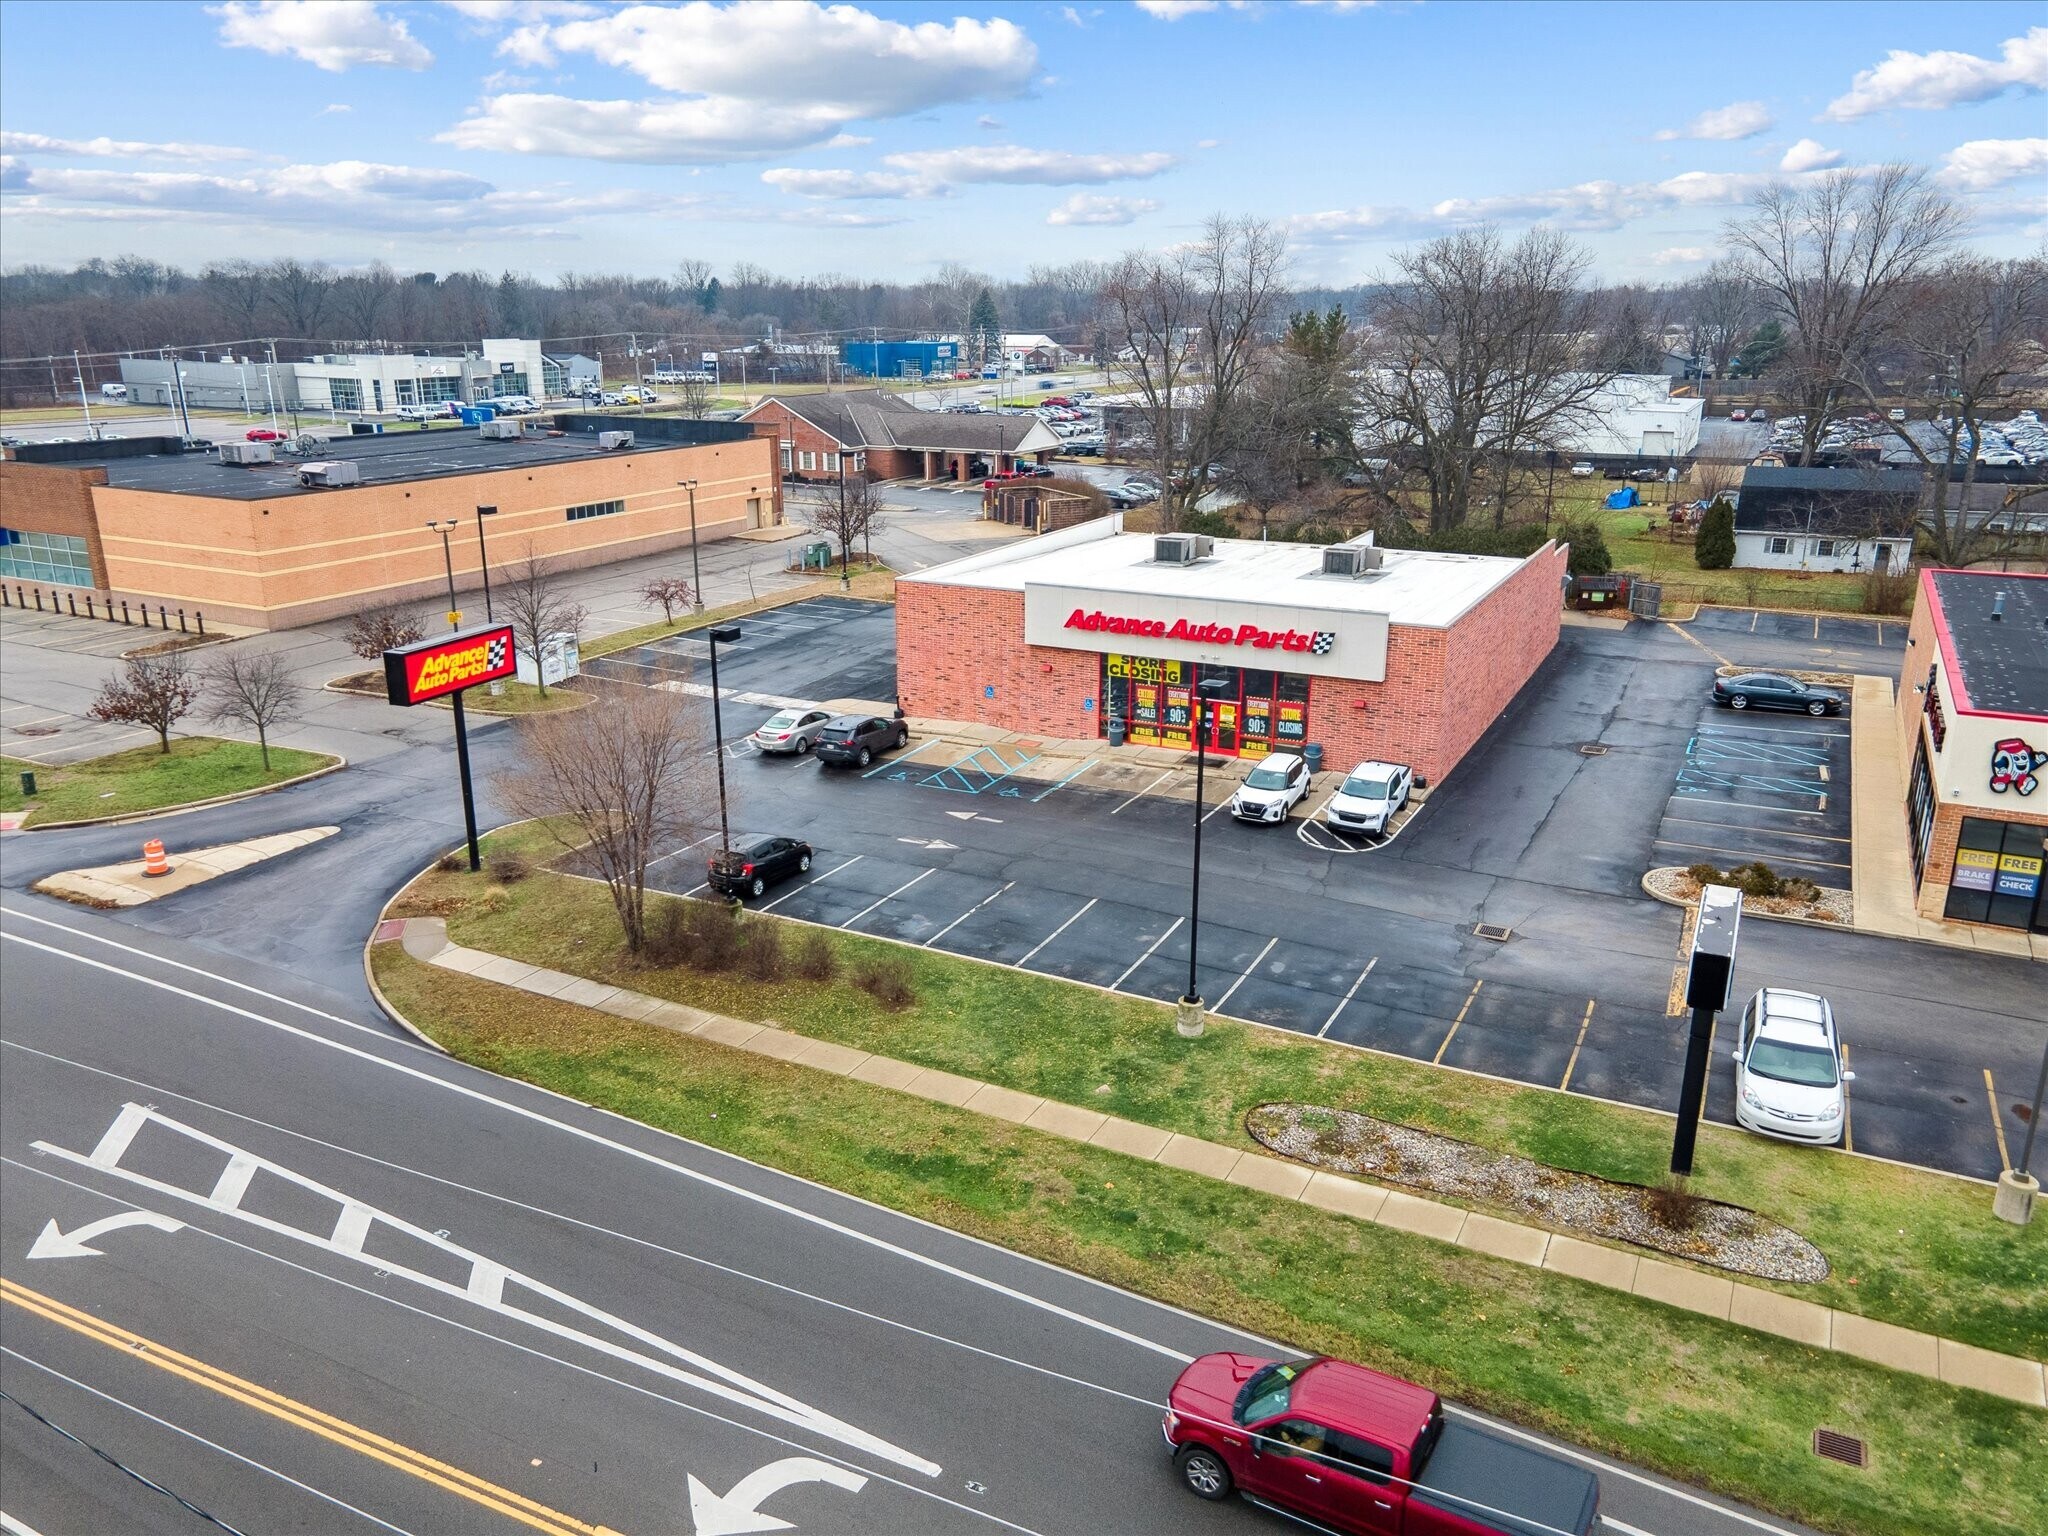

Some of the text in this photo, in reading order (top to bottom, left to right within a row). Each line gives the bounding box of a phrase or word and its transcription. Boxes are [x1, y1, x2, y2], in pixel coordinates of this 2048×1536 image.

[1064, 609, 1309, 652] Advance Auto Parts
[420, 645, 485, 677] Advance
[1121, 655, 1167, 670] STORE
[414, 661, 484, 693] Auto Parts
[1110, 663, 1179, 683] CLOSING
[1281, 708, 1302, 721] STORE
[1135, 727, 1154, 736] FREE
[1278, 721, 1303, 734] CLOSING
[1167, 731, 1187, 741] FREE
[1246, 741, 1268, 751] FREE
[1961, 852, 1994, 865] FREE
[2004, 858, 2038, 871] FREE
[1957, 869, 1992, 880] BRAKE
[2000, 880, 2033, 891] CHECK
